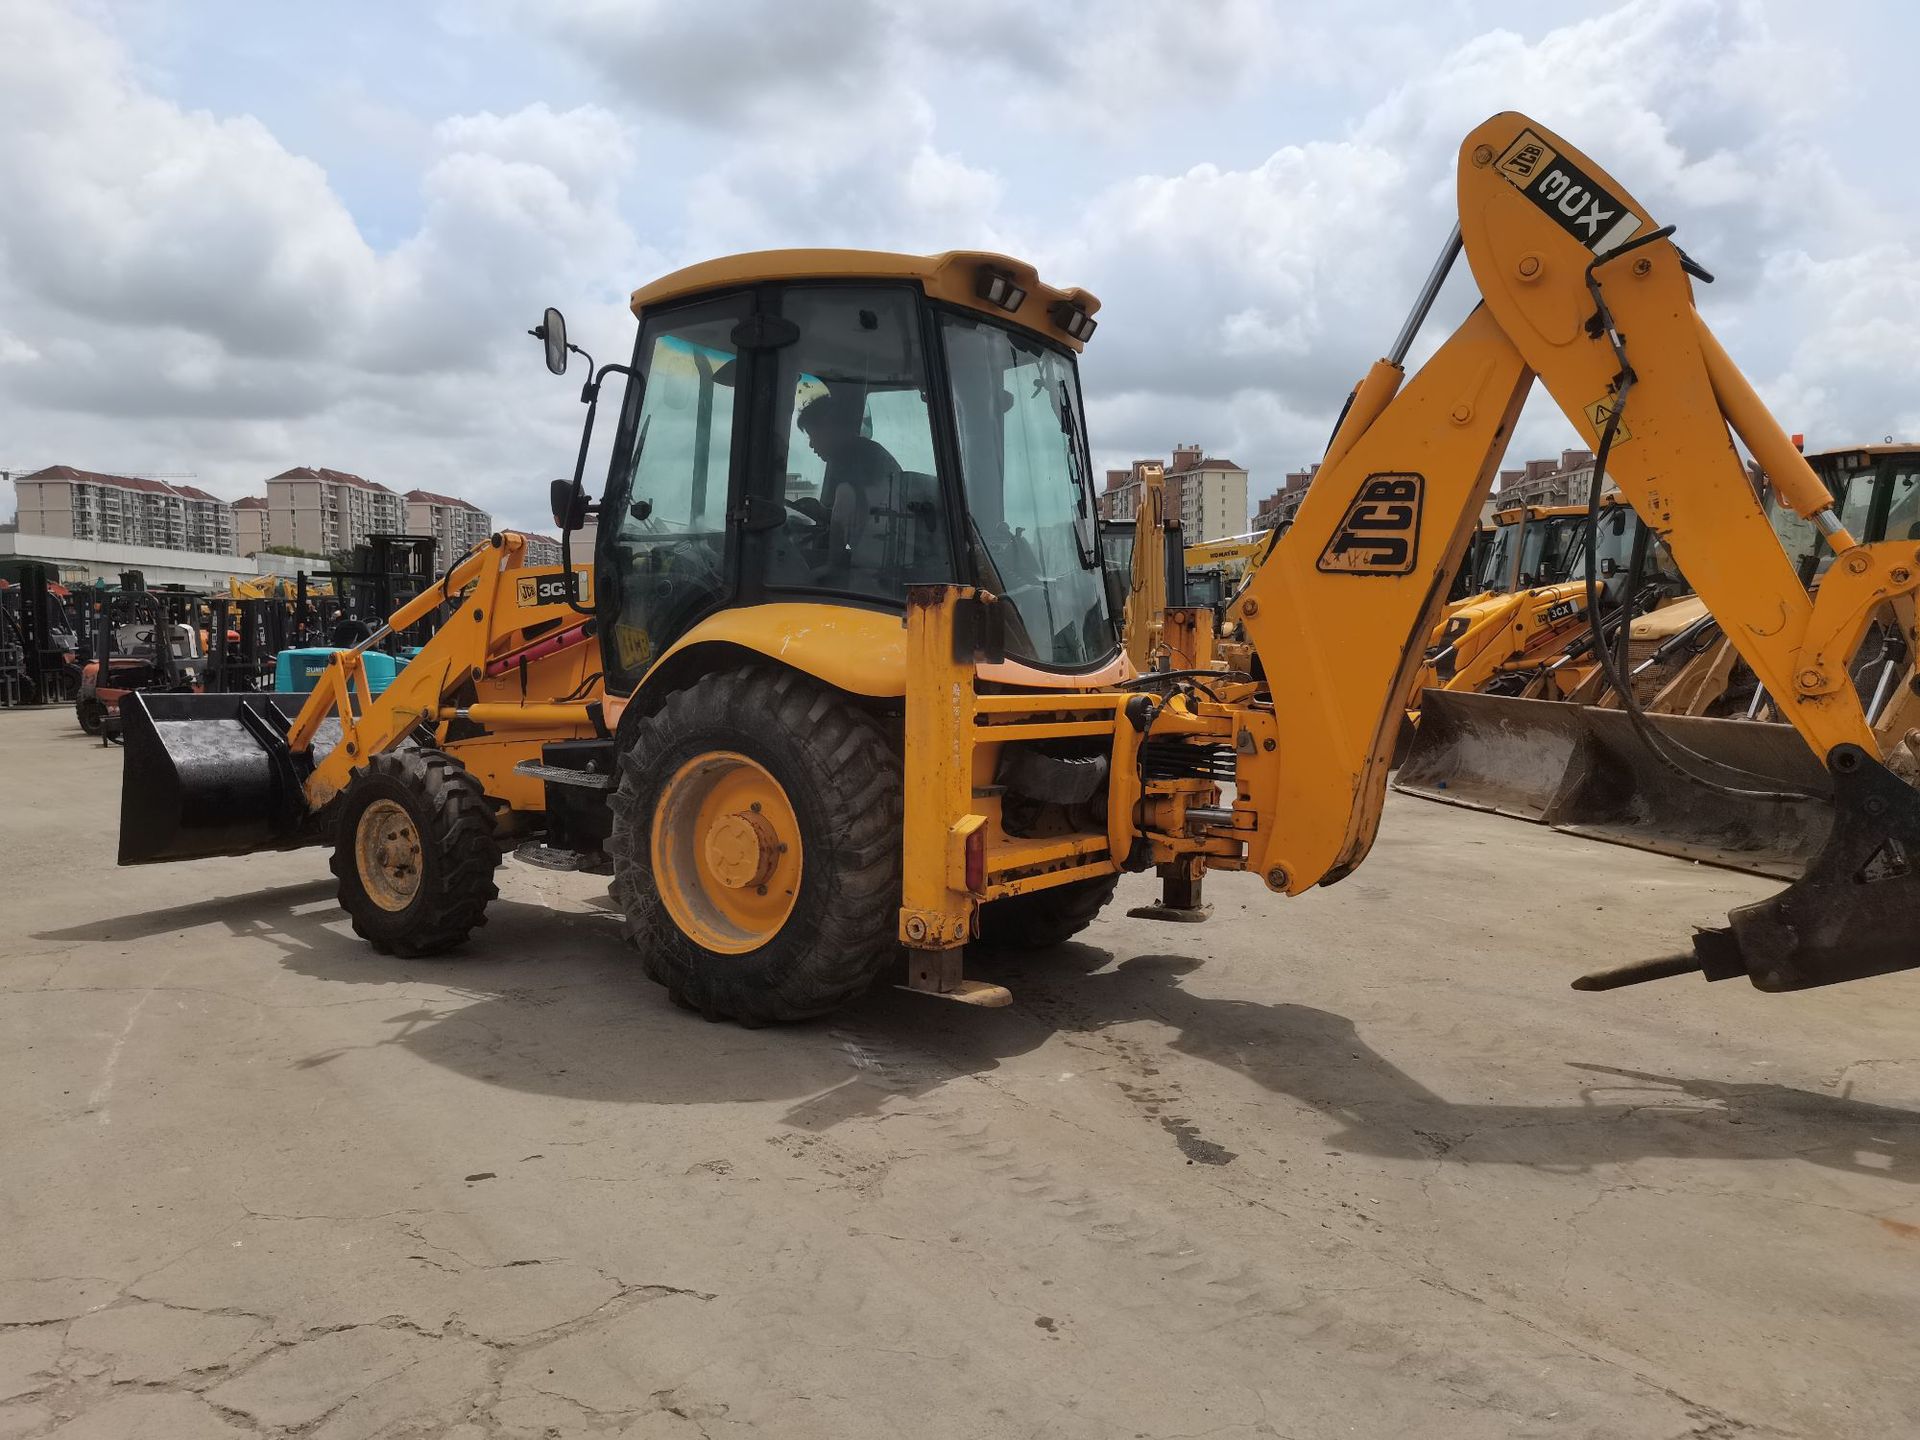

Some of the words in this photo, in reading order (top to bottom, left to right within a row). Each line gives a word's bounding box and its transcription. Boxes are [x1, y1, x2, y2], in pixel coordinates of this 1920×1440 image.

[1508, 146, 1541, 175] JCB
[1332, 480, 1416, 565] JCB
[1552, 605, 1569, 618] 3CX
